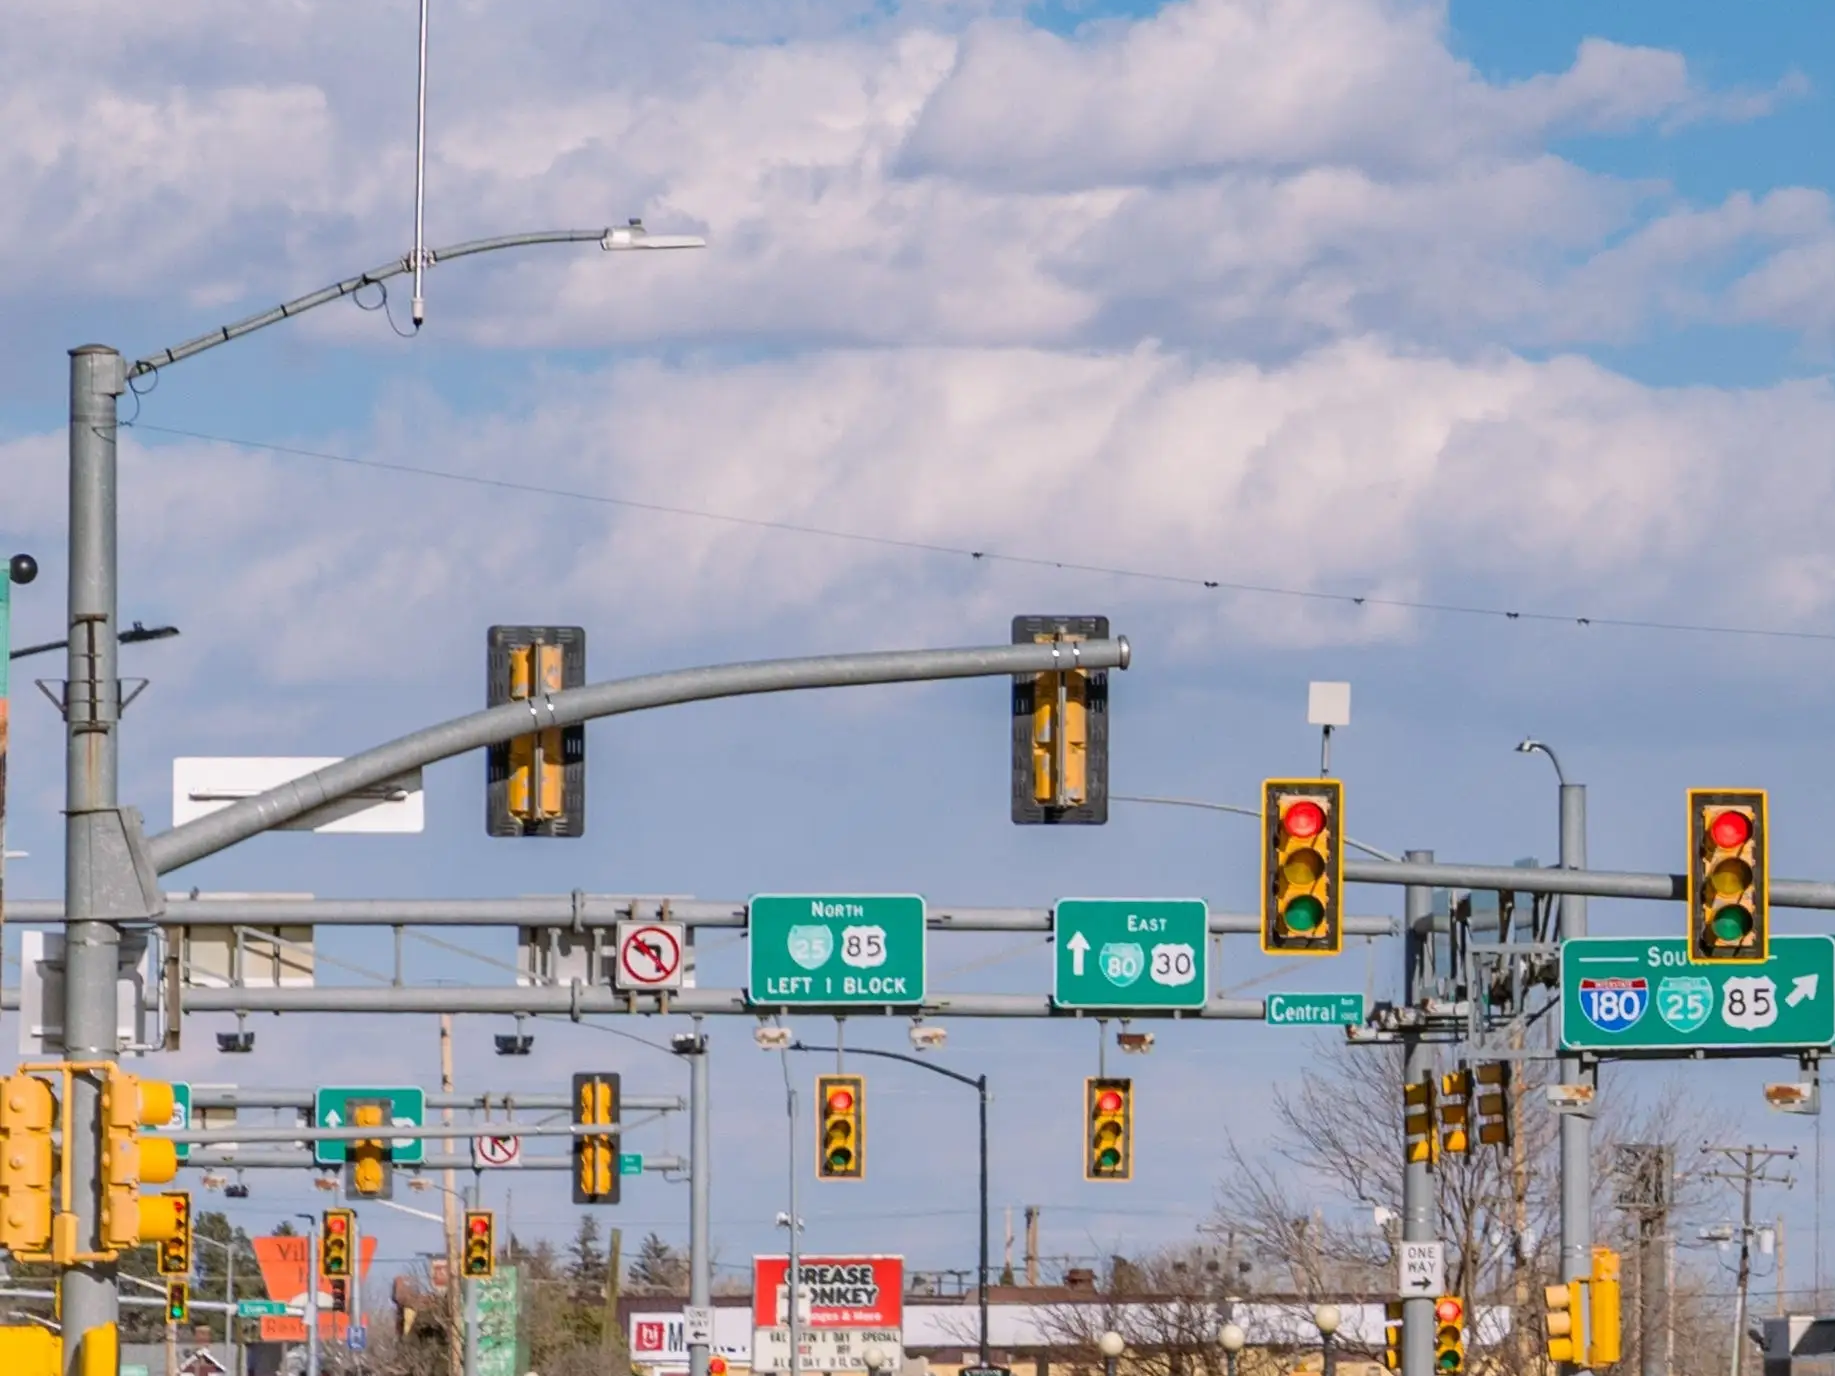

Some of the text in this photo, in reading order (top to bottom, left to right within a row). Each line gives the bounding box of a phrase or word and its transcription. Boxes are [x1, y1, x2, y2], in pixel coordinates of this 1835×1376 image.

[795, 935, 882, 960] 25 85
[1647, 946, 1712, 967] SOU
[1107, 952, 1191, 978] 80 30
[767, 977, 907, 995] LEFT 1 BLOCK
[1271, 996, 1337, 1023] Central
[1590, 988, 1771, 1022] 180 25 85
[1407, 1247, 1436, 1259] ONE
[1407, 1261, 1437, 1274] WAY
[809, 1286, 877, 1304] NKEY
